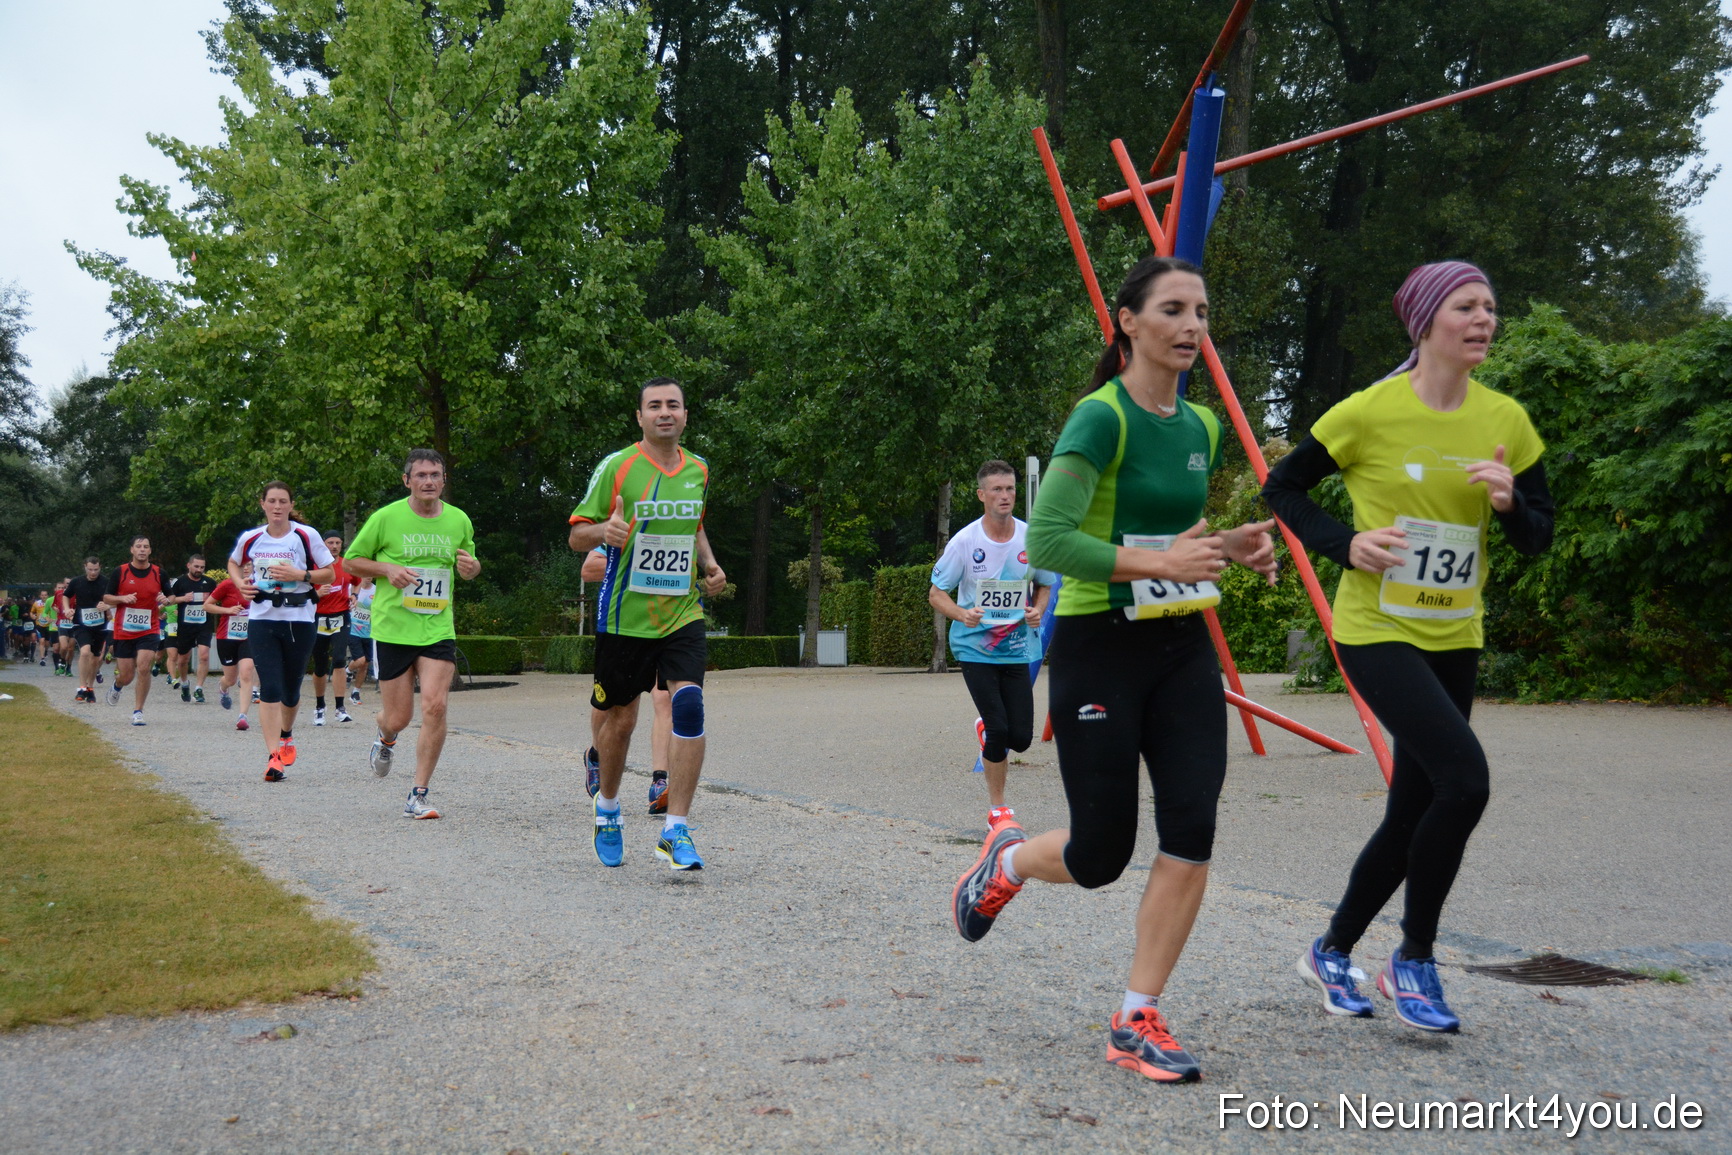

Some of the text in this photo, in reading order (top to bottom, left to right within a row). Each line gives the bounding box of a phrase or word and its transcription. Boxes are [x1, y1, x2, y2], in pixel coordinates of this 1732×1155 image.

[403, 534, 451, 545] NOVINA
[404, 547, 452, 557] HOTELS
[639, 549, 689, 572] 2825
[1414, 546, 1475, 584] 134
[645, 576, 680, 587] Sleiman
[413, 579, 442, 597] 214
[415, 600, 440, 608] Thomas
[981, 591, 1022, 608] 2587
[1416, 592, 1453, 607] Anika
[84, 612, 102, 620] 2851
[187, 609, 205, 617] 2478
[991, 611, 1010, 619] Viktor
[127, 614, 149, 624] 2882
[1078, 712, 1106, 720] skinfit
